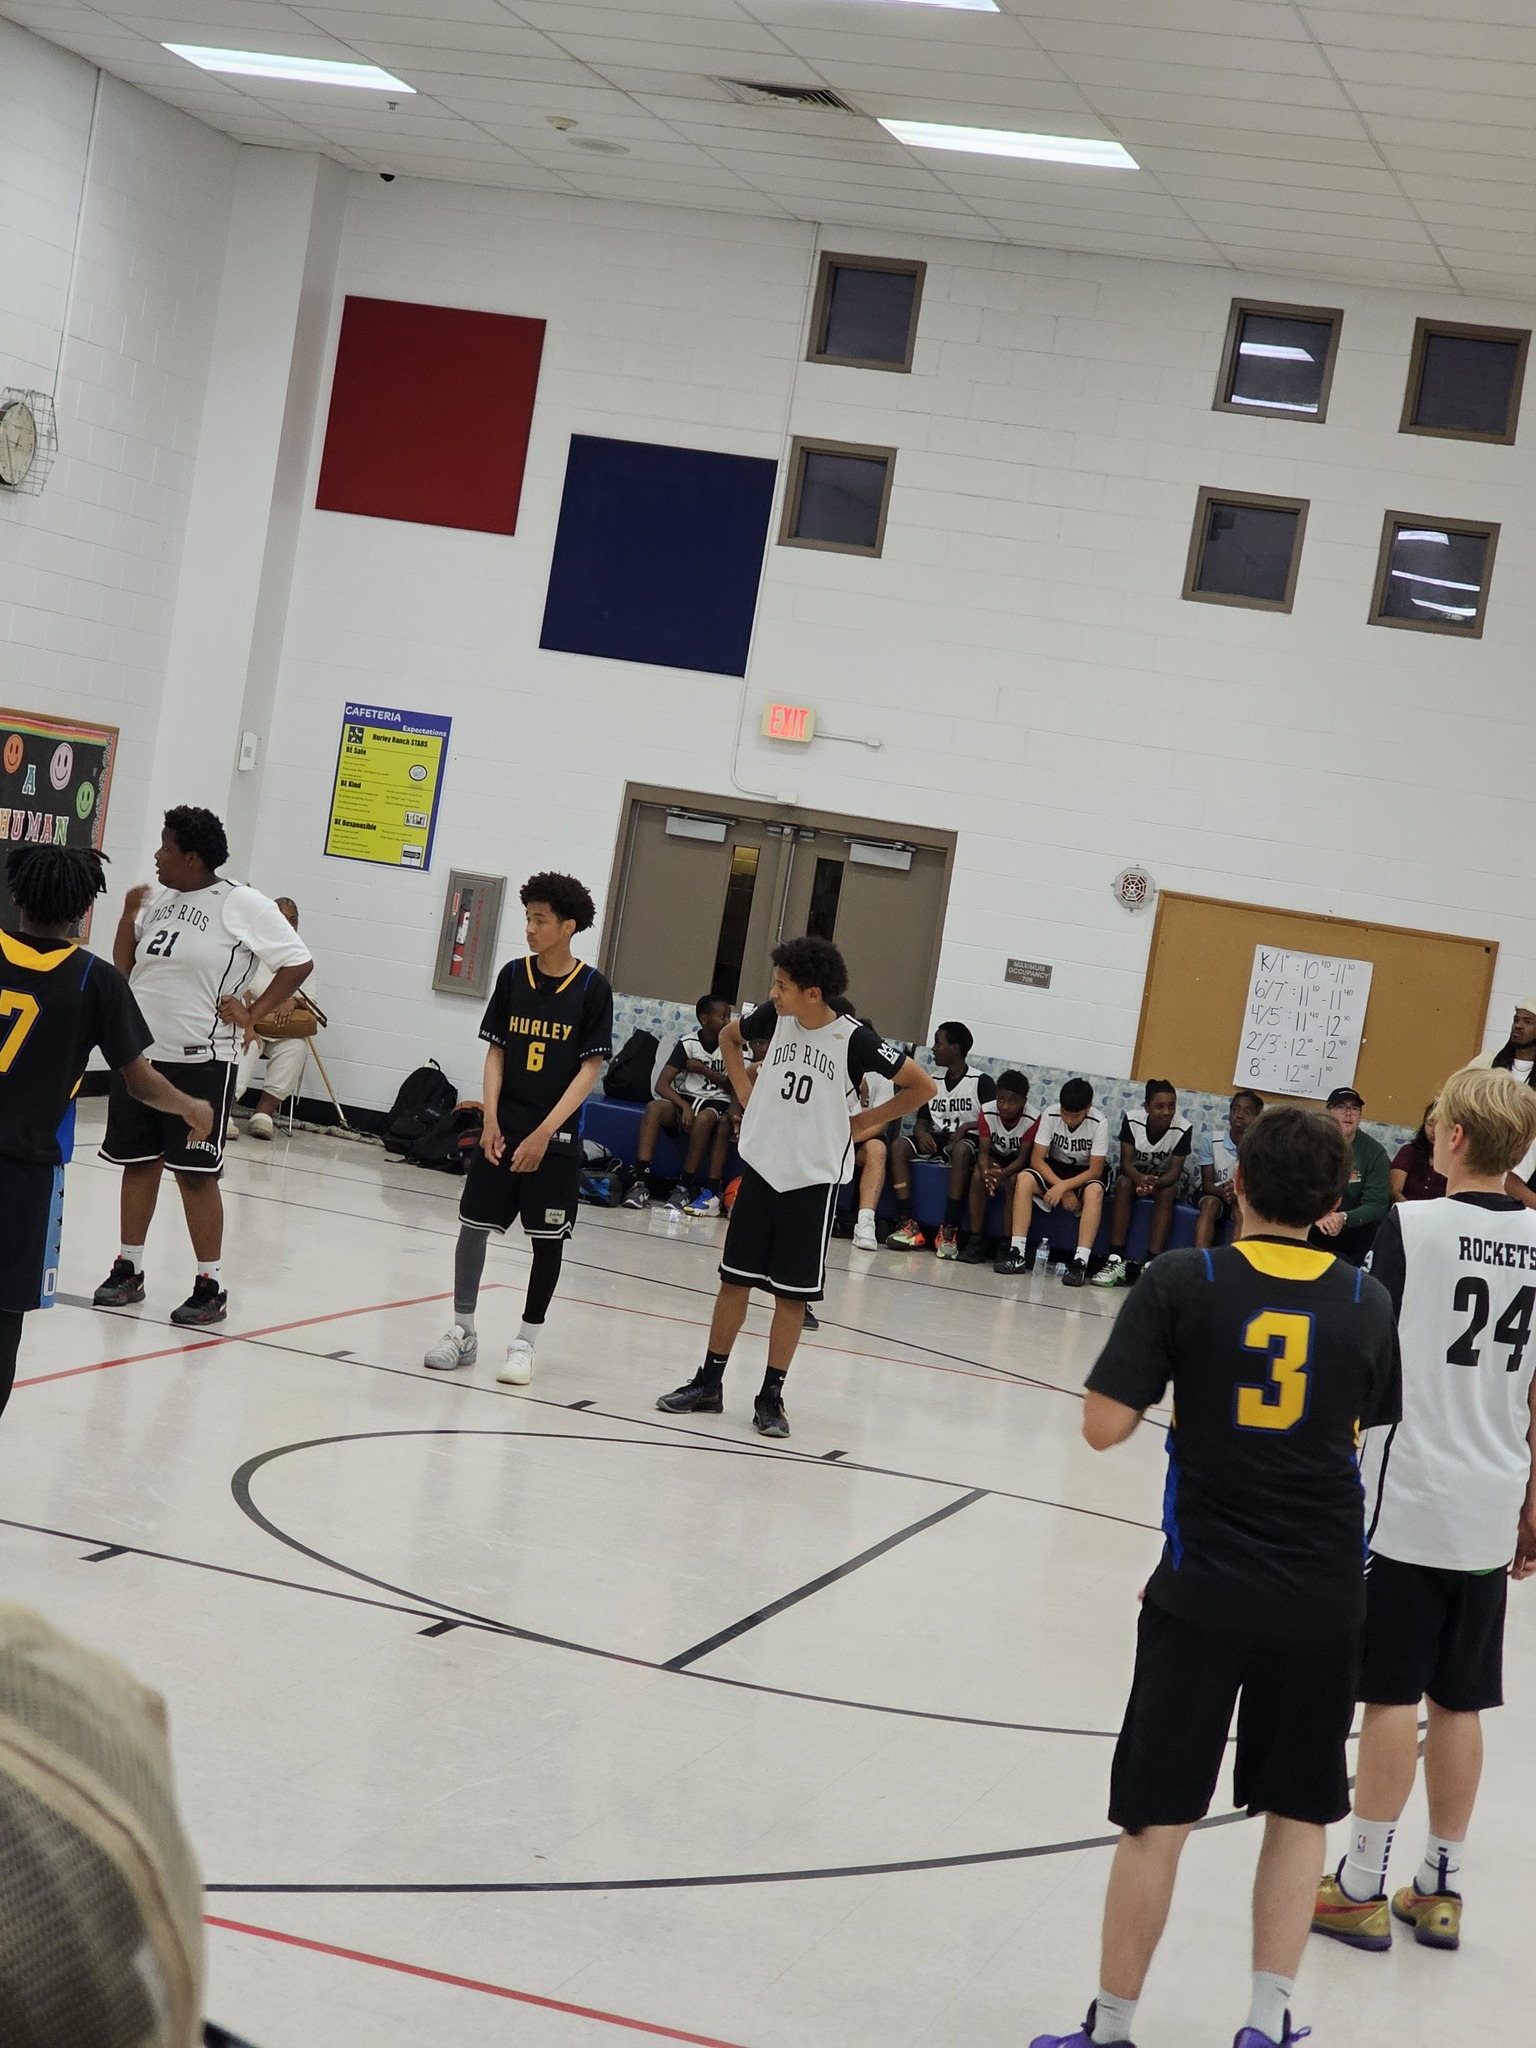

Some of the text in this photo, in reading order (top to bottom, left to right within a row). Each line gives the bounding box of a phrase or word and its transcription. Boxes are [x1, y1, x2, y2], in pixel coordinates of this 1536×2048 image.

[345, 706, 402, 722] CAFETERIA
[769, 704, 808, 739] EXIT
[372, 733, 428, 748] Hurley Ranch STARS
[402, 725, 447, 738] Expectations
[346, 746, 353, 754] BE
[22, 764, 37, 795] A
[340, 779, 361, 789] BE Kind
[0, 807, 69, 846] HUMAN
[334, 818, 377, 831] BE Responsible
[177, 904, 209, 932] RIOS
[146, 929, 180, 958] 21
[1008, 966, 1049, 979] OCCUPANCY
[1013, 961, 1046, 972] MAXIMUM
[0, 986, 42, 1075] 7
[509, 1015, 573, 1041] HURLEY
[526, 1041, 546, 1072] 6
[772, 1042, 835, 1081] DOS RIOS
[781, 1070, 813, 1105] 30
[931, 1098, 972, 1113] DOS RIOS
[186, 1140, 218, 1156] ROCKETS
[1052, 1132, 1093, 1152] DOS RIOS
[1459, 1236, 1536, 1271] ROCKETS
[1446, 1276, 1536, 1373] 24
[1234, 1306, 1316, 1435] 3
